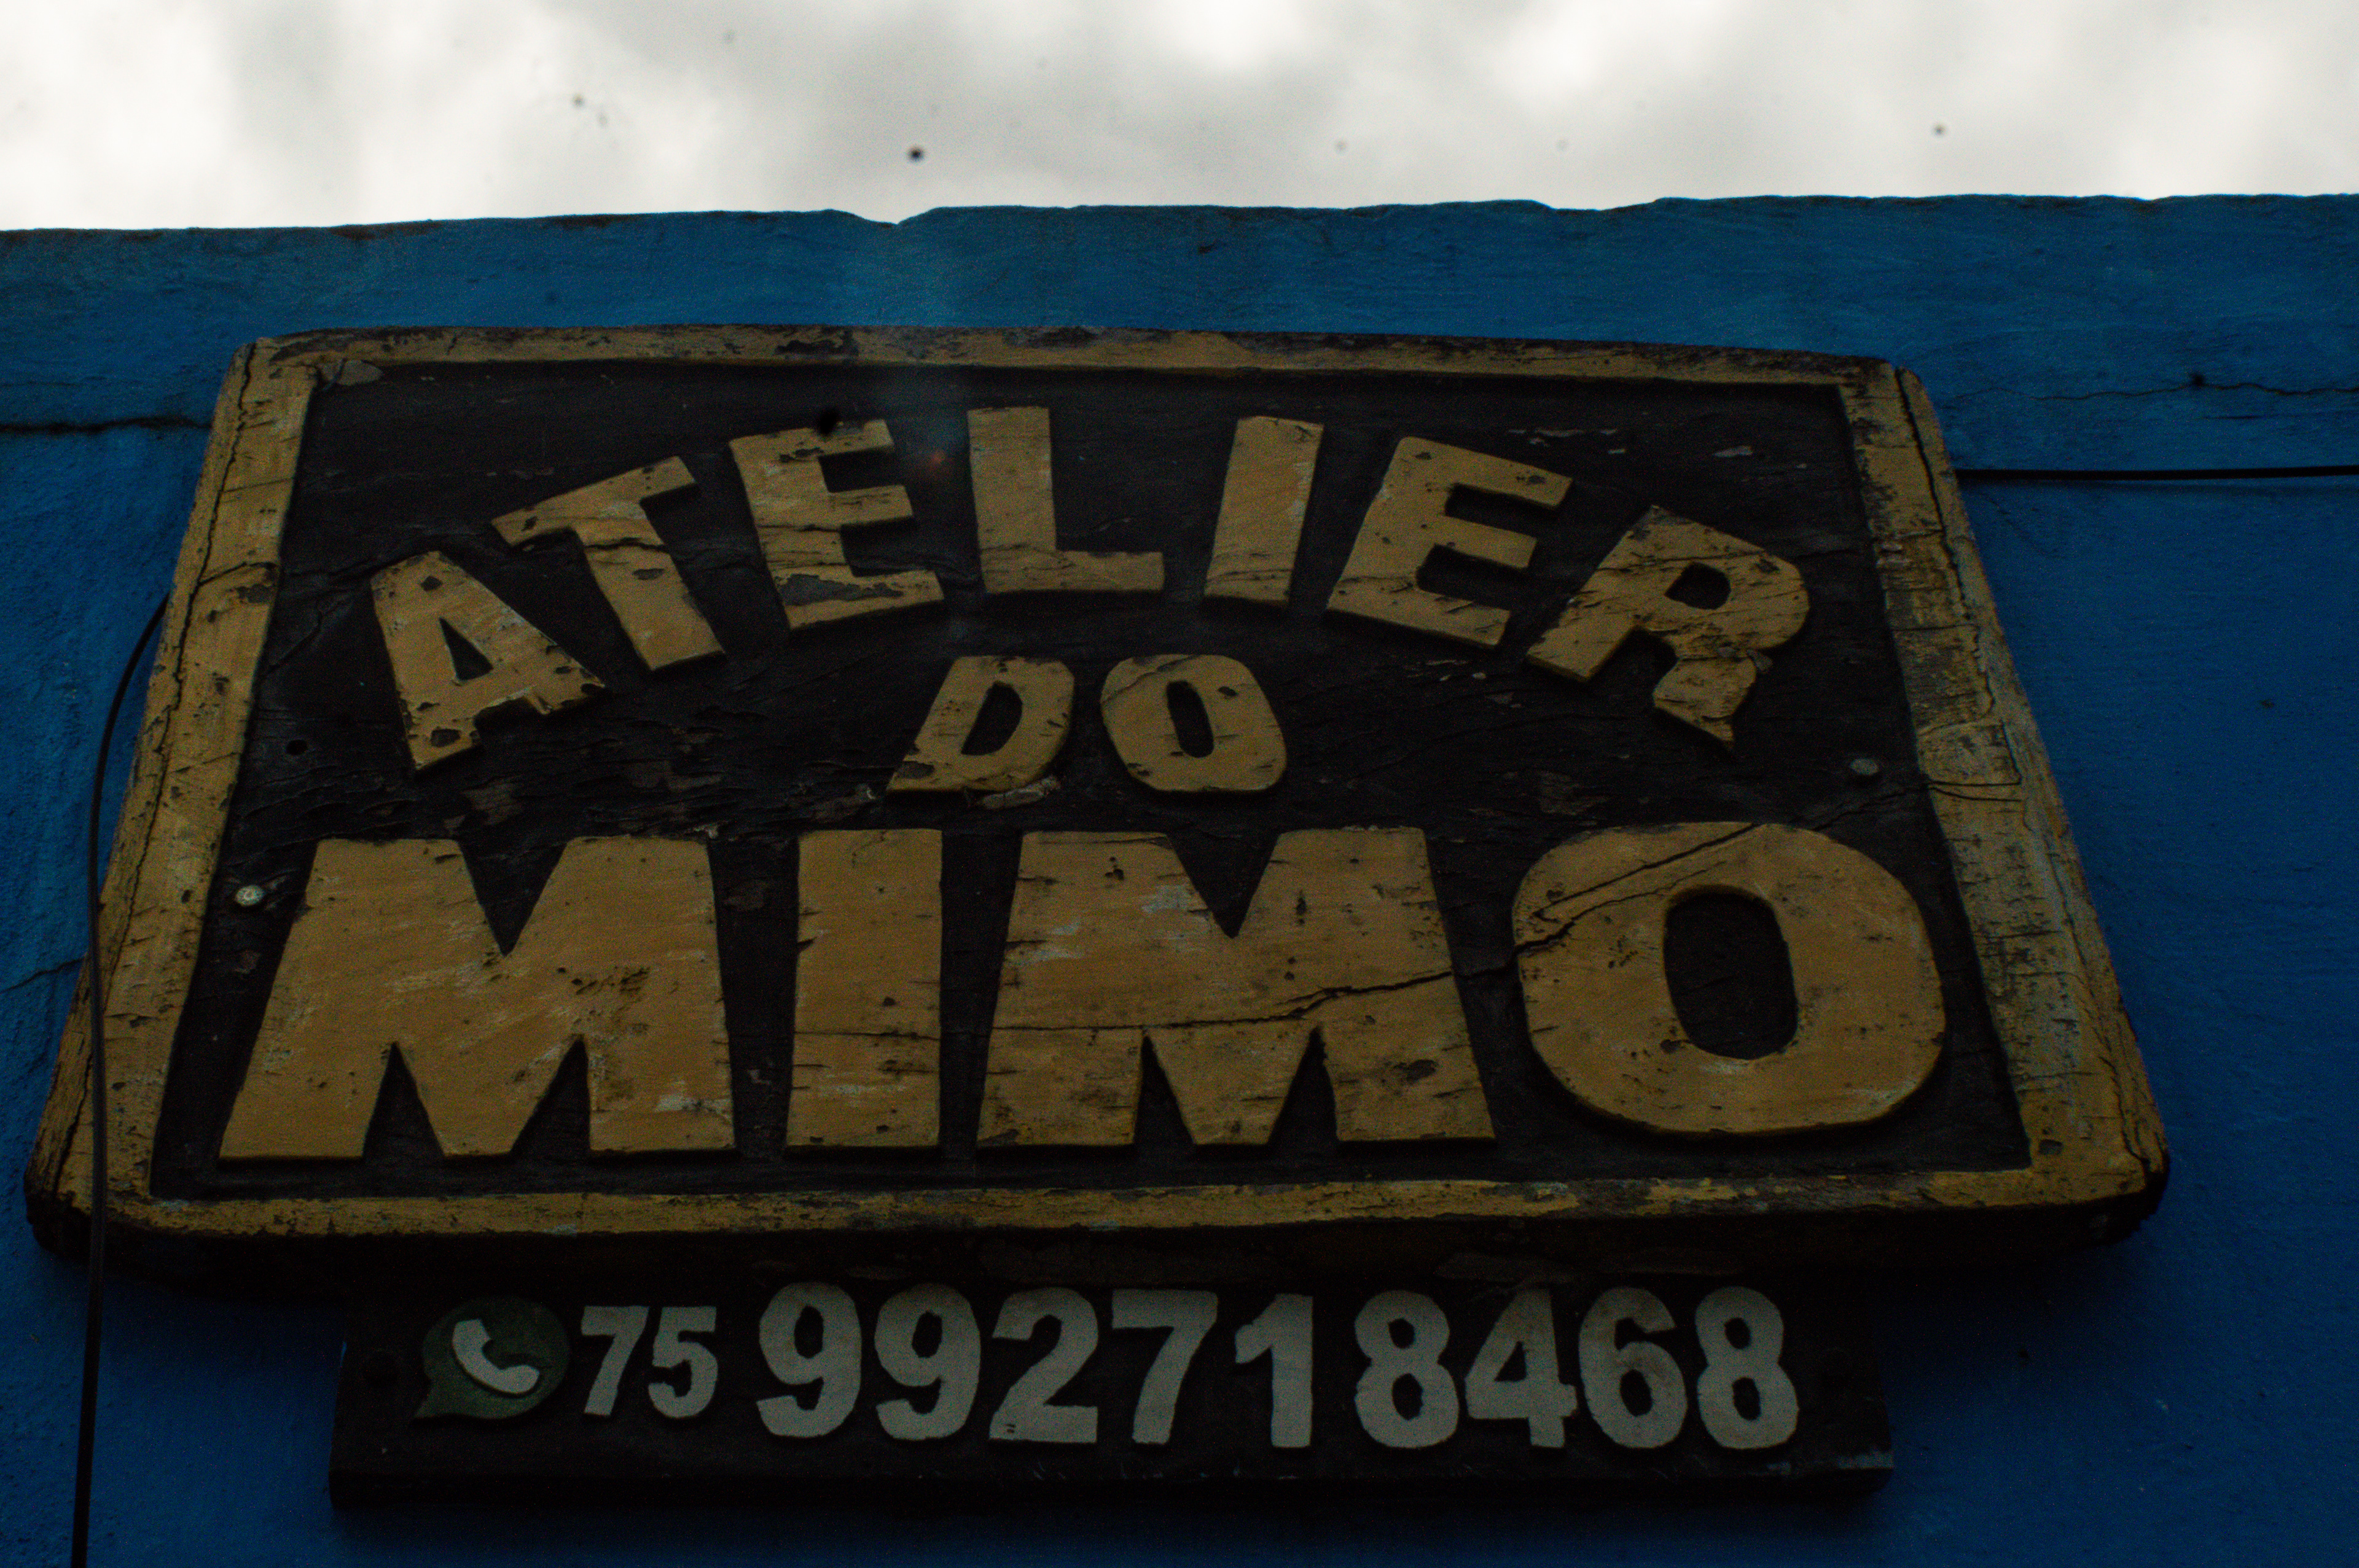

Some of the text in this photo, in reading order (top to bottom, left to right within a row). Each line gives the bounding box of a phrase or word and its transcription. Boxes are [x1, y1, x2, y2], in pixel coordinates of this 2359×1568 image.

[370, 406, 1810, 771] ATELIER
[886, 653, 1288, 794] DO
[217, 821, 1946, 1158] MIMO
[580, 1305, 718, 1419] 75
